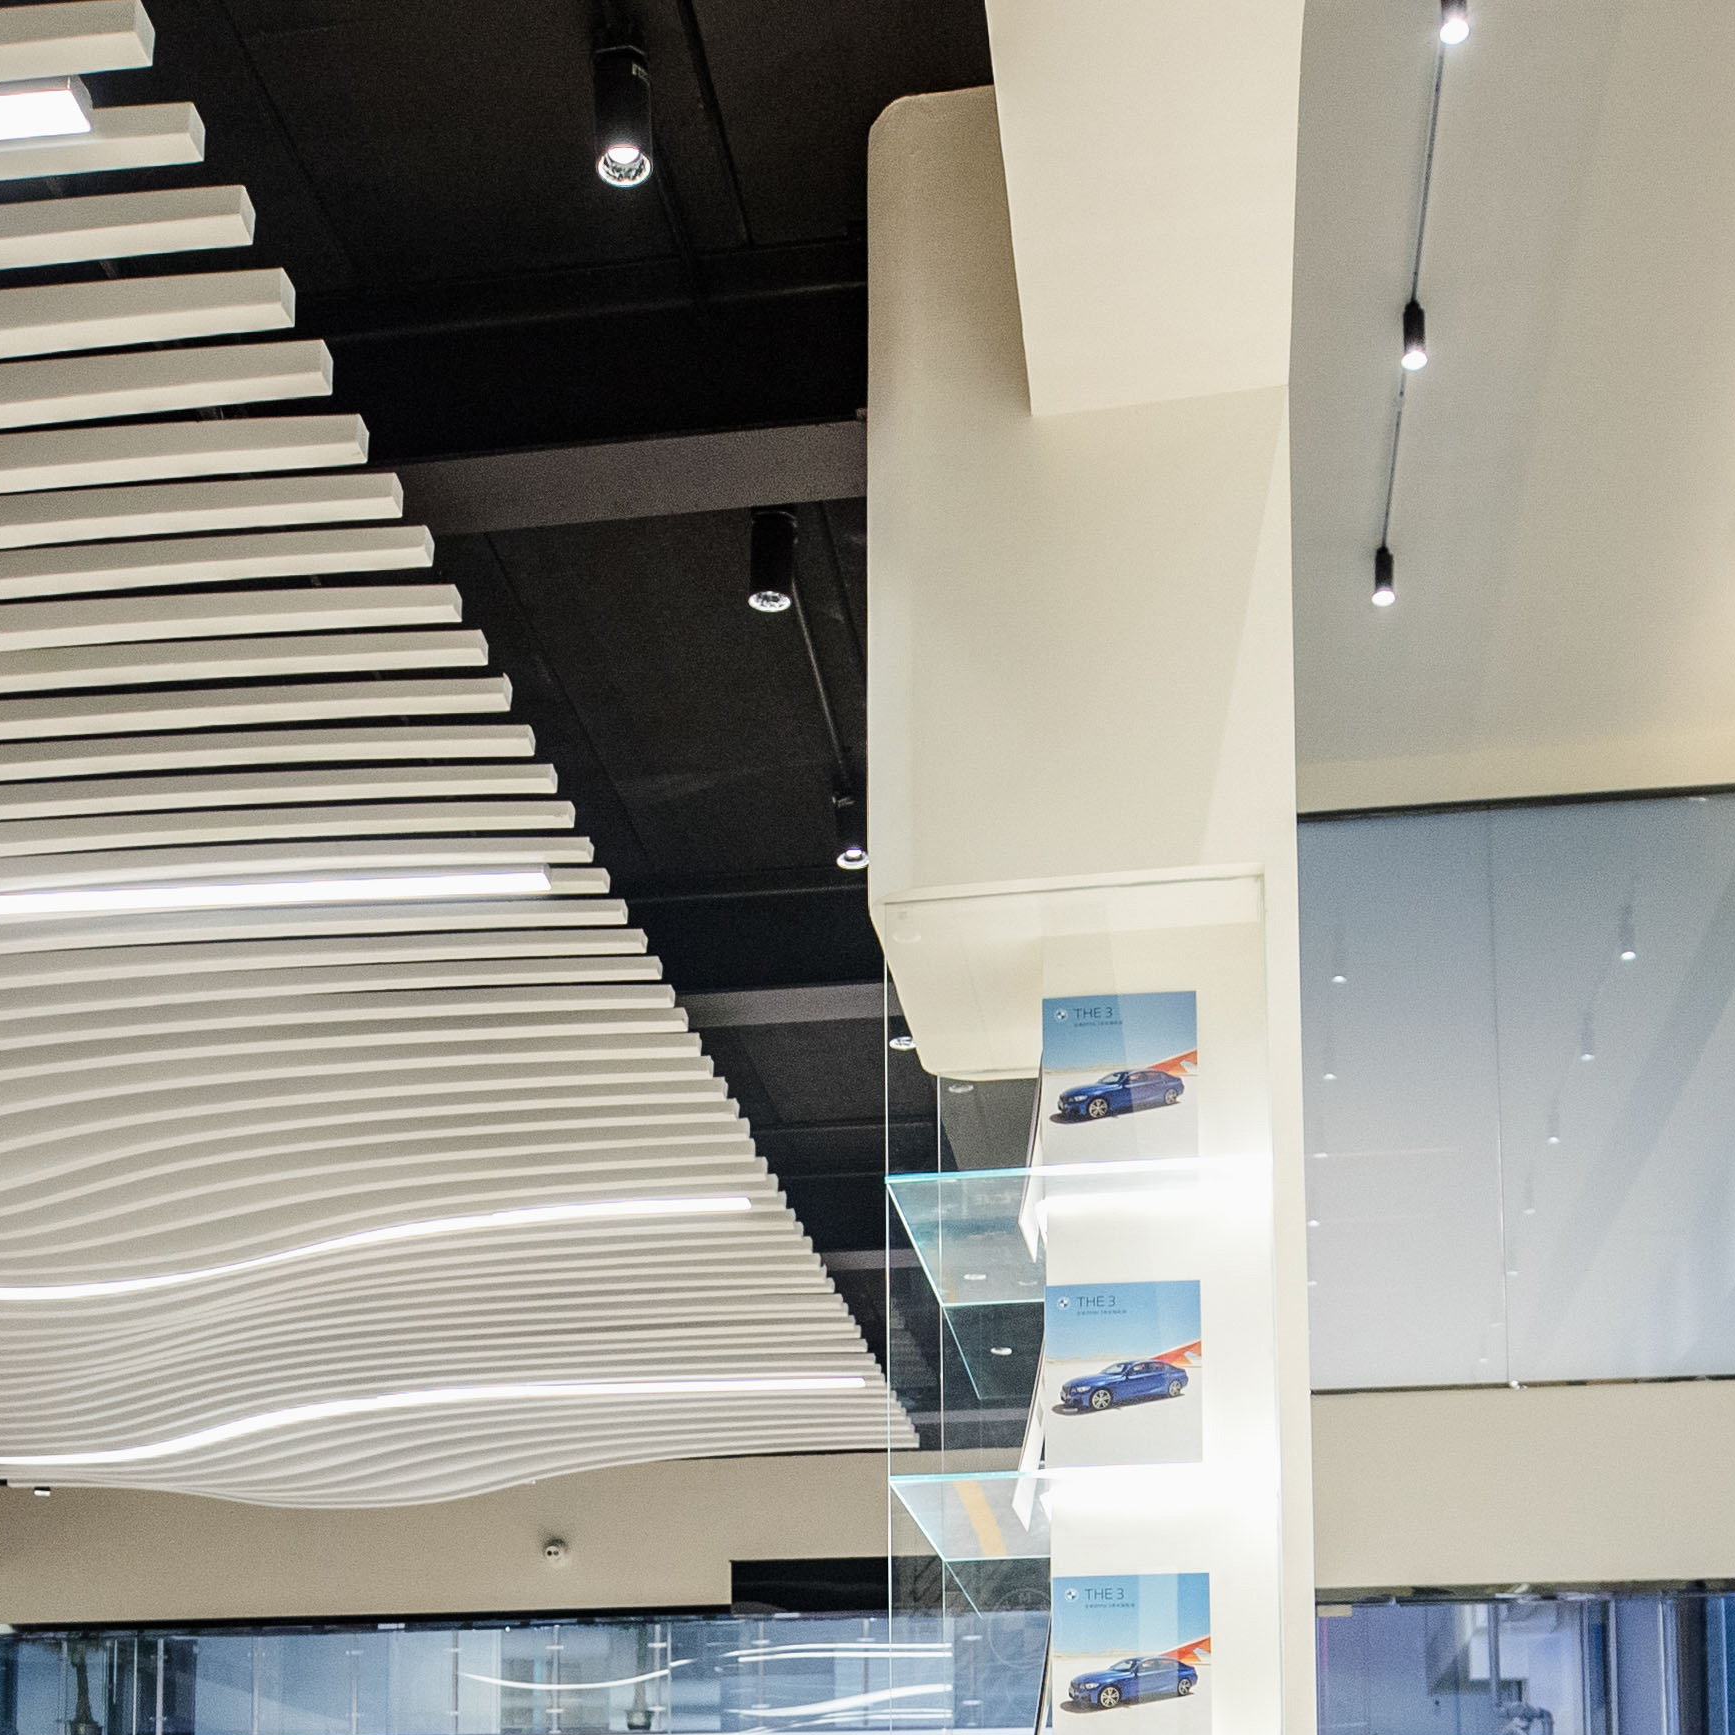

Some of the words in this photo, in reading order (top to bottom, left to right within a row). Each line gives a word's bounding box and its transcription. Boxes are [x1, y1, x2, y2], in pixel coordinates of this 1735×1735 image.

[1073, 1007, 1102, 1019] THE
[1105, 1006, 1113, 1018] 3
[1077, 1295, 1105, 1308] THE
[1109, 1295, 1116, 1306] 3
[1085, 1588, 1113, 1600] THE
[1117, 1588, 1125, 1599] 3
